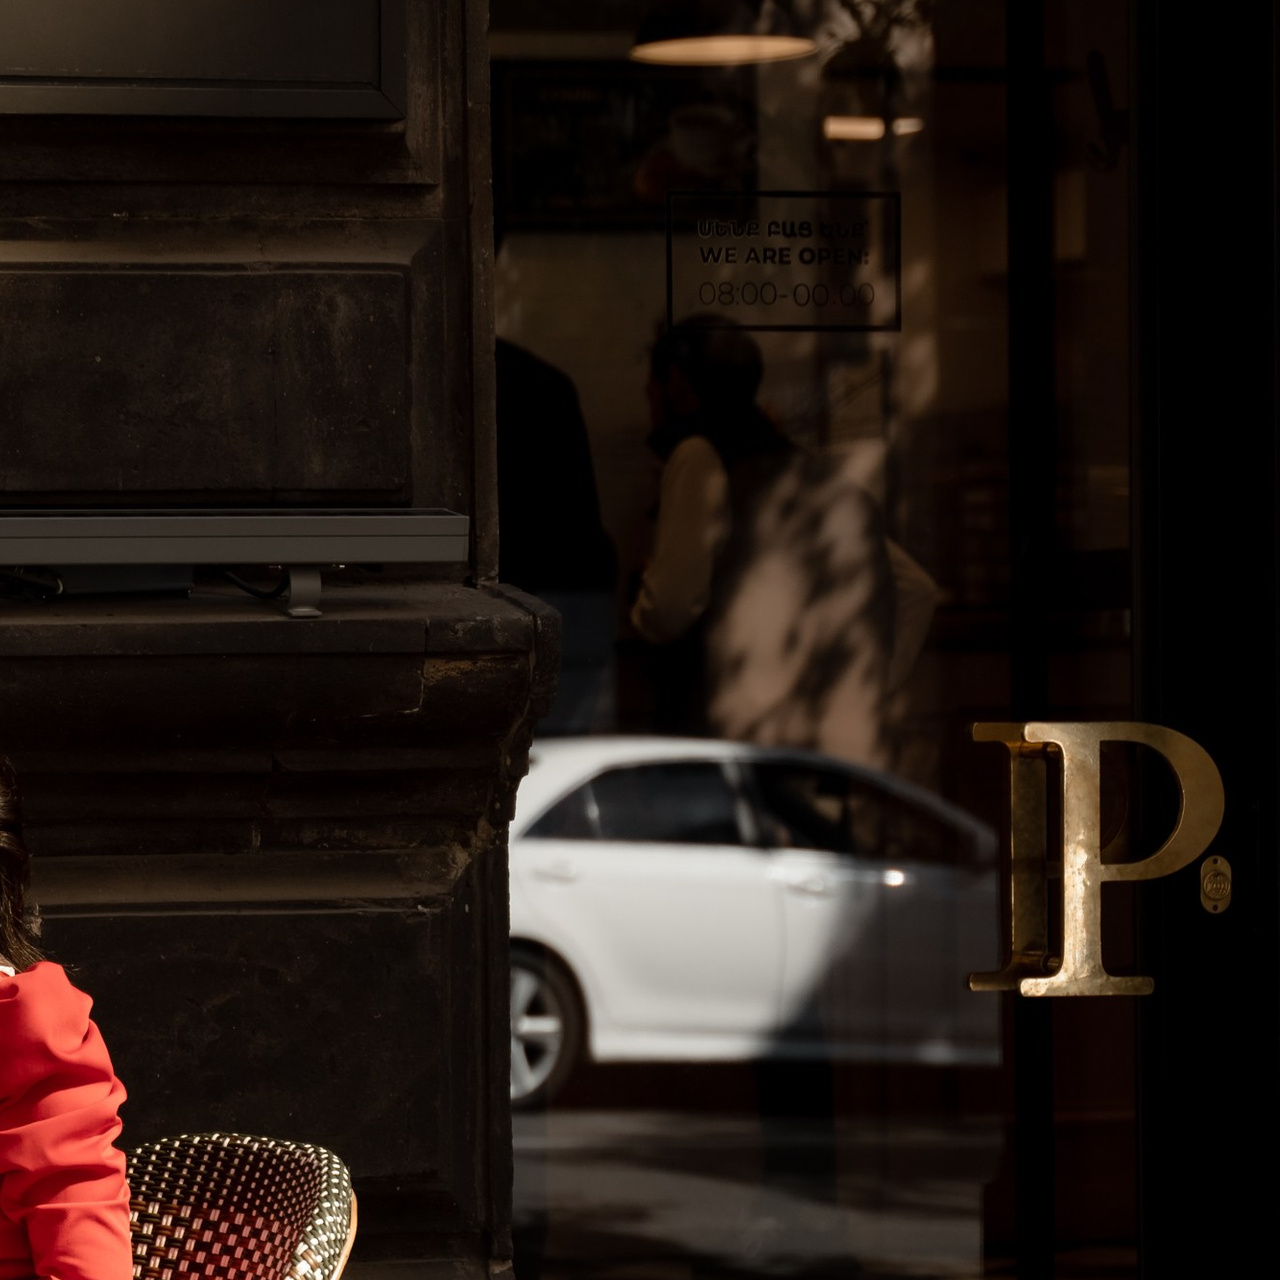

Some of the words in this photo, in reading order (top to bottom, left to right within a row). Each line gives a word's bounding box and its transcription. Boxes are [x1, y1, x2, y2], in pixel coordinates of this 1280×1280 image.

[699, 247, 737, 265] WE
[745, 247, 791, 265] ARE
[798, 247, 870, 266] OPEN:
